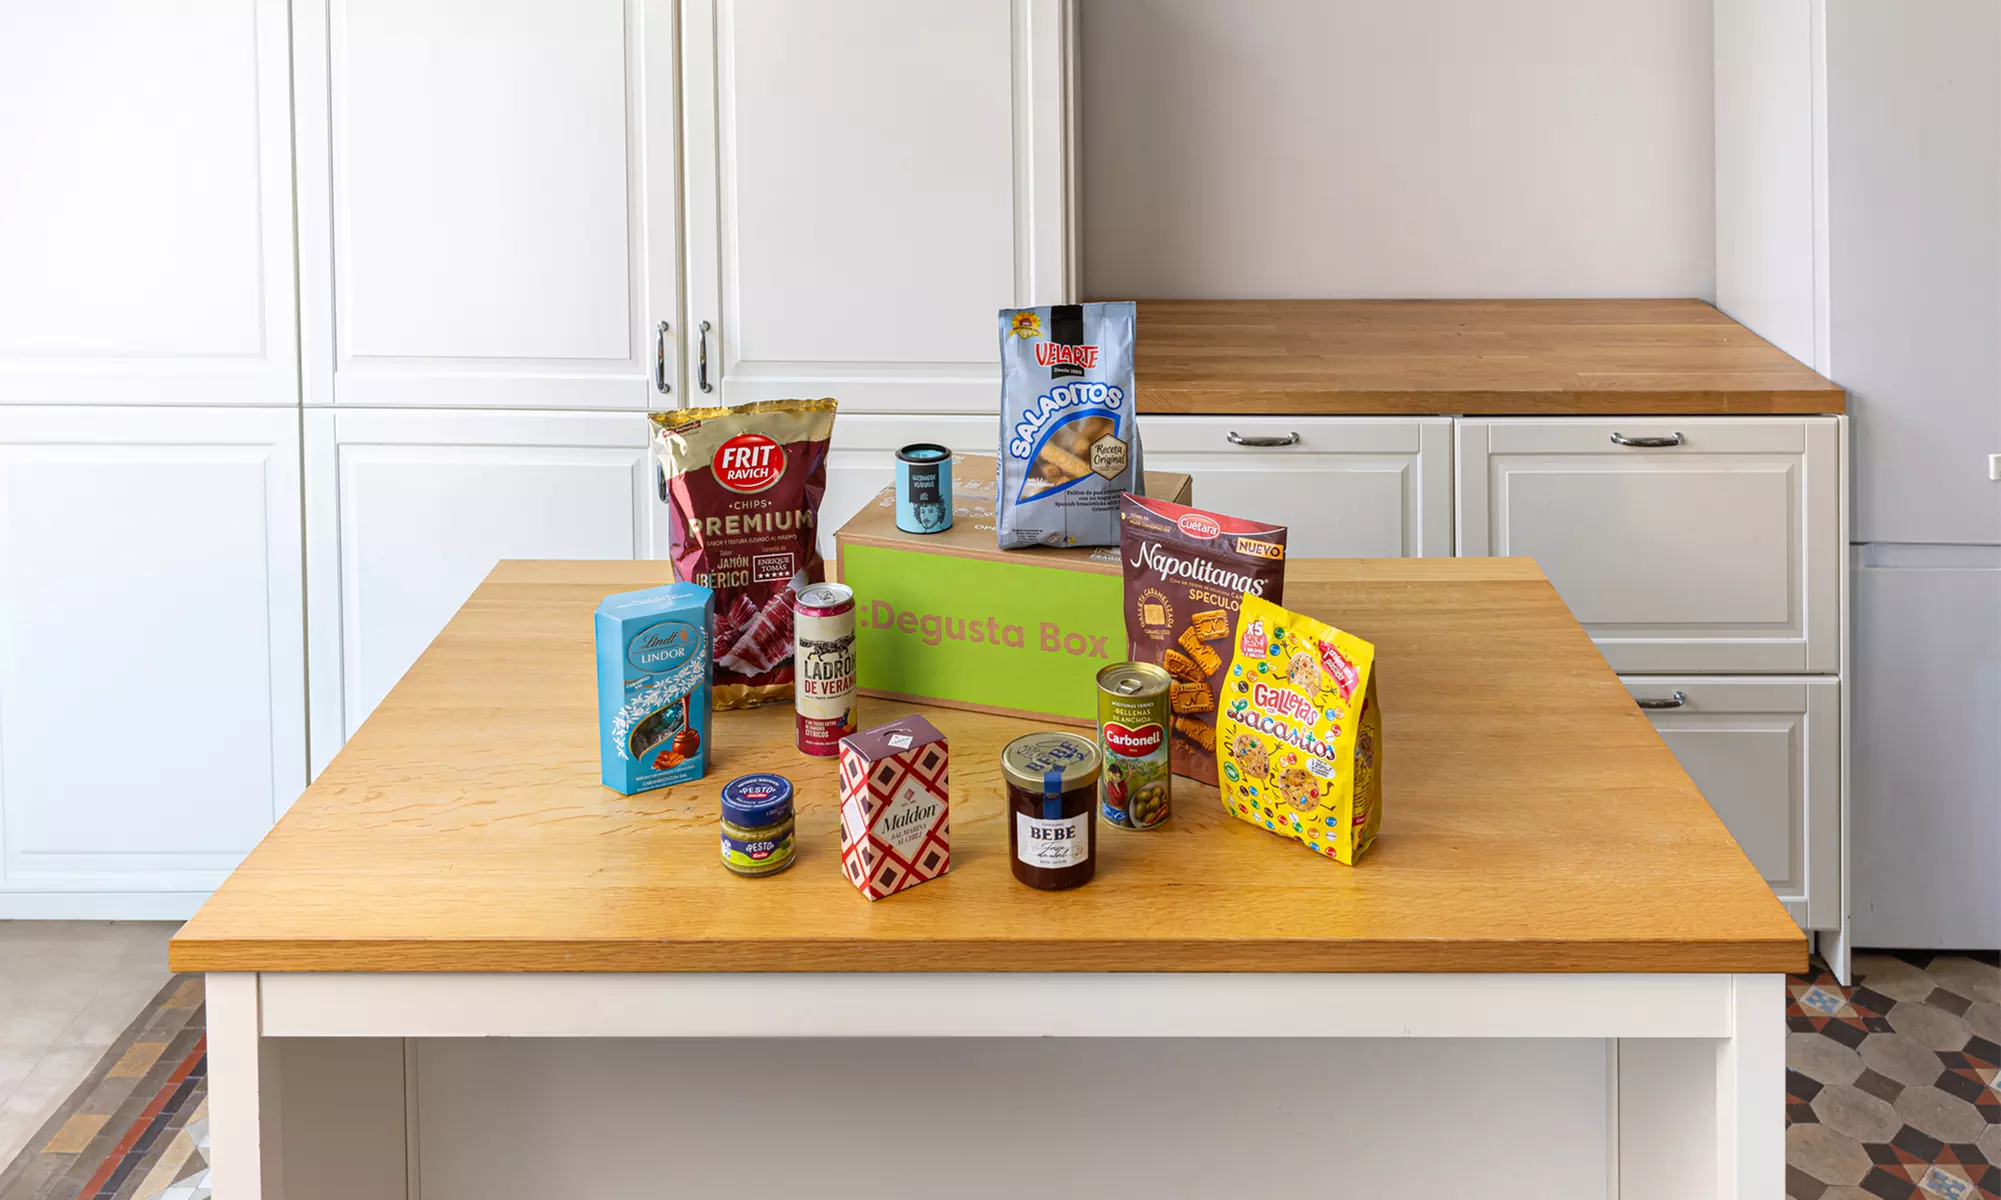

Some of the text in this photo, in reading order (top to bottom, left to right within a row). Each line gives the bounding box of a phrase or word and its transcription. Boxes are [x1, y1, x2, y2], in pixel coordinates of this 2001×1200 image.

[1035, 343, 1099, 369] VELARTE
[1011, 382, 1124, 460] SALADITOS
[722, 445, 776, 469] FRIT
[1095, 444, 1123, 455] Receta
[1094, 454, 1125, 467] Original
[728, 467, 769, 480] RAVICH
[734, 500, 767, 510] CHIPS
[688, 509, 814, 538] PREMIUM
[1179, 518, 1218, 535] Cuétara
[1240, 540, 1281, 558] NUEVO
[717, 555, 749, 569] JAMÓN
[758, 557, 790, 566] ENRIQUE
[1130, 541, 1265, 598] Napolitanas
[696, 569, 749, 589] IBÉRICO
[1248, 620, 1264, 637] x5
[640, 631, 679, 648] Lindt
[1040, 622, 1109, 659] Box
[641, 648, 685, 664] LINDOR
[805, 679, 818, 694] DE
[1106, 730, 1160, 747] Carbonell
[1226, 699, 1336, 761] Lacasitos
[742, 786, 773, 795] PESTO
[881, 804, 936, 835] Maldon
[1030, 824, 1076, 840] BEBE
[747, 841, 772, 853] PESTO
